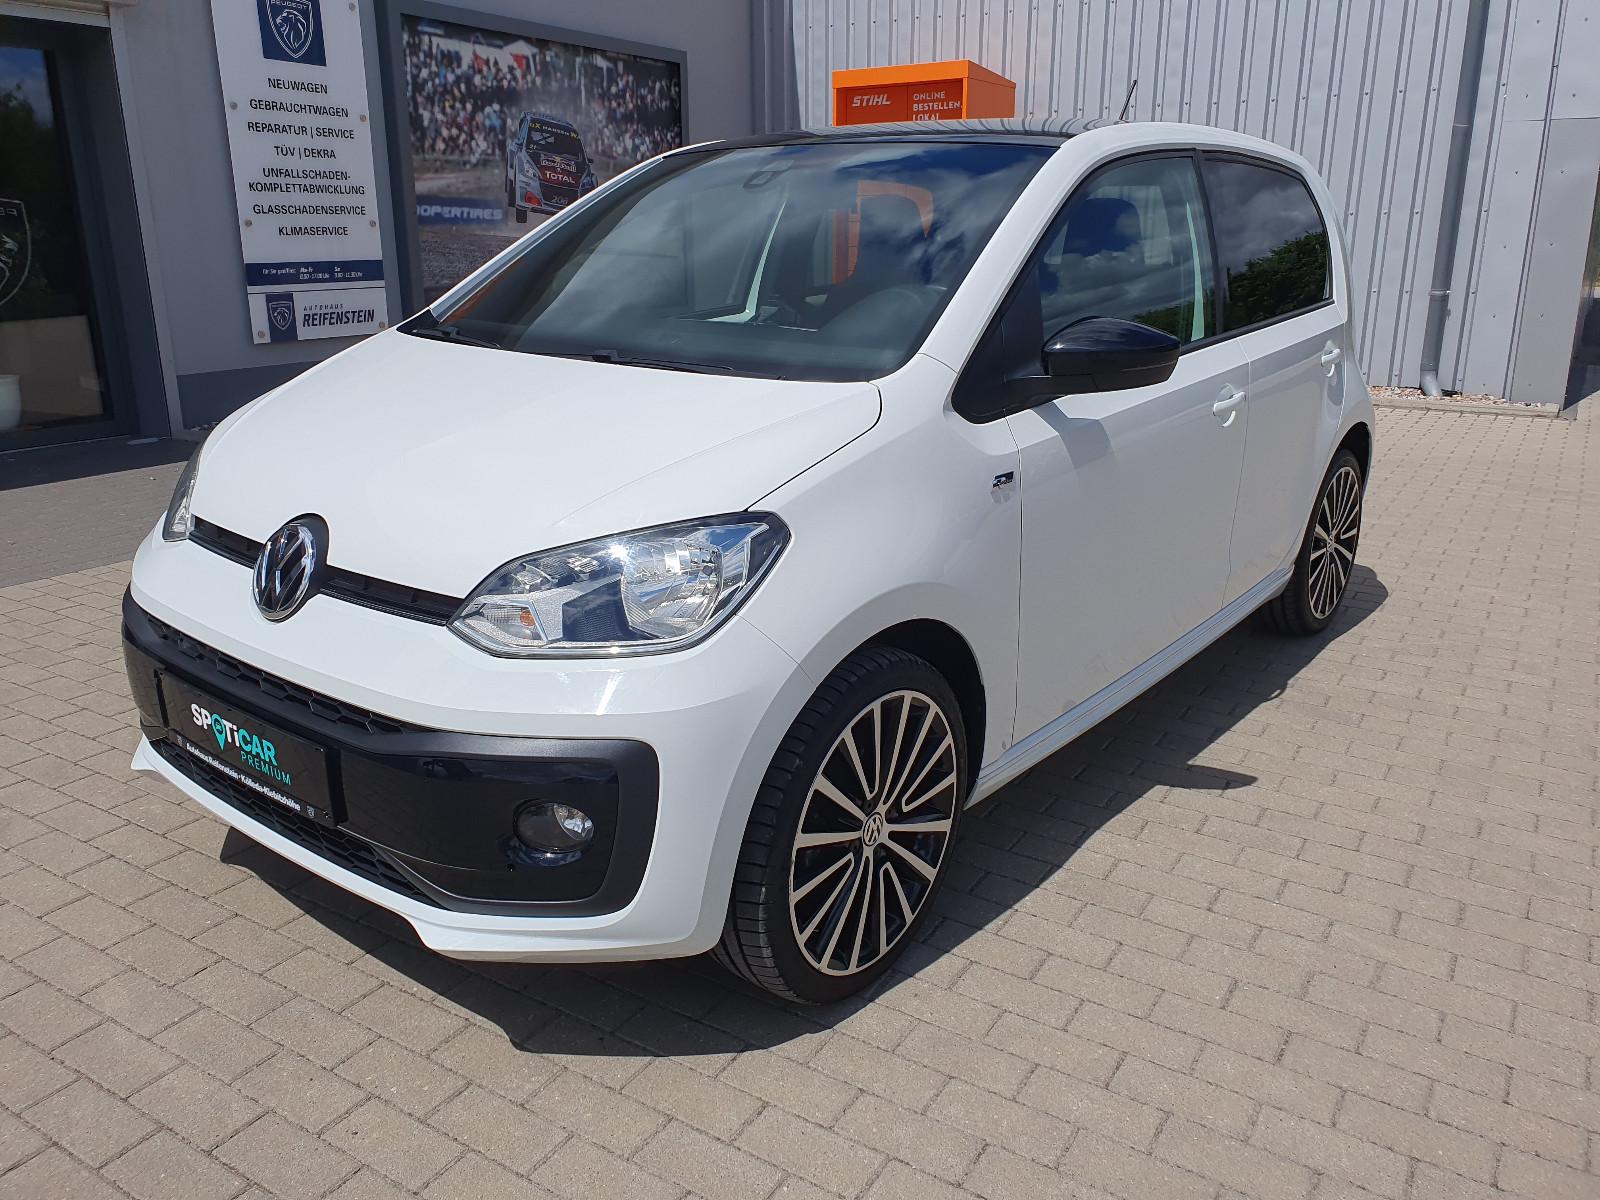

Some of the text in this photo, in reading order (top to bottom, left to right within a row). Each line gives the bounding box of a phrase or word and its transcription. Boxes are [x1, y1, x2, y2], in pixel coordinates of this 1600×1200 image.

[267, 77, 328, 94] NEUWAGEN
[852, 94, 891, 107] STIHL
[913, 91, 945, 101] ONLINE
[249, 98, 349, 118] GEBRAUCHTWAGEN
[247, 121, 355, 139] REPARATUR SERVICE
[273, 144, 337, 159] TÜV DEKRA
[262, 167, 351, 181] UNFALLSCHADEN-
[544, 170, 575, 184] TOTAL
[249, 182, 365, 195] KOMPLETTABWICKLUNG
[253, 203, 366, 216] GLASSCHADENSERVICE
[278, 226, 349, 236] KLIMASERVICE
[303, 303, 344, 311] AUTOHAUS
[302, 309, 375, 328] REIFENSTEIN
[240, 750, 292, 786] PREMIUM
